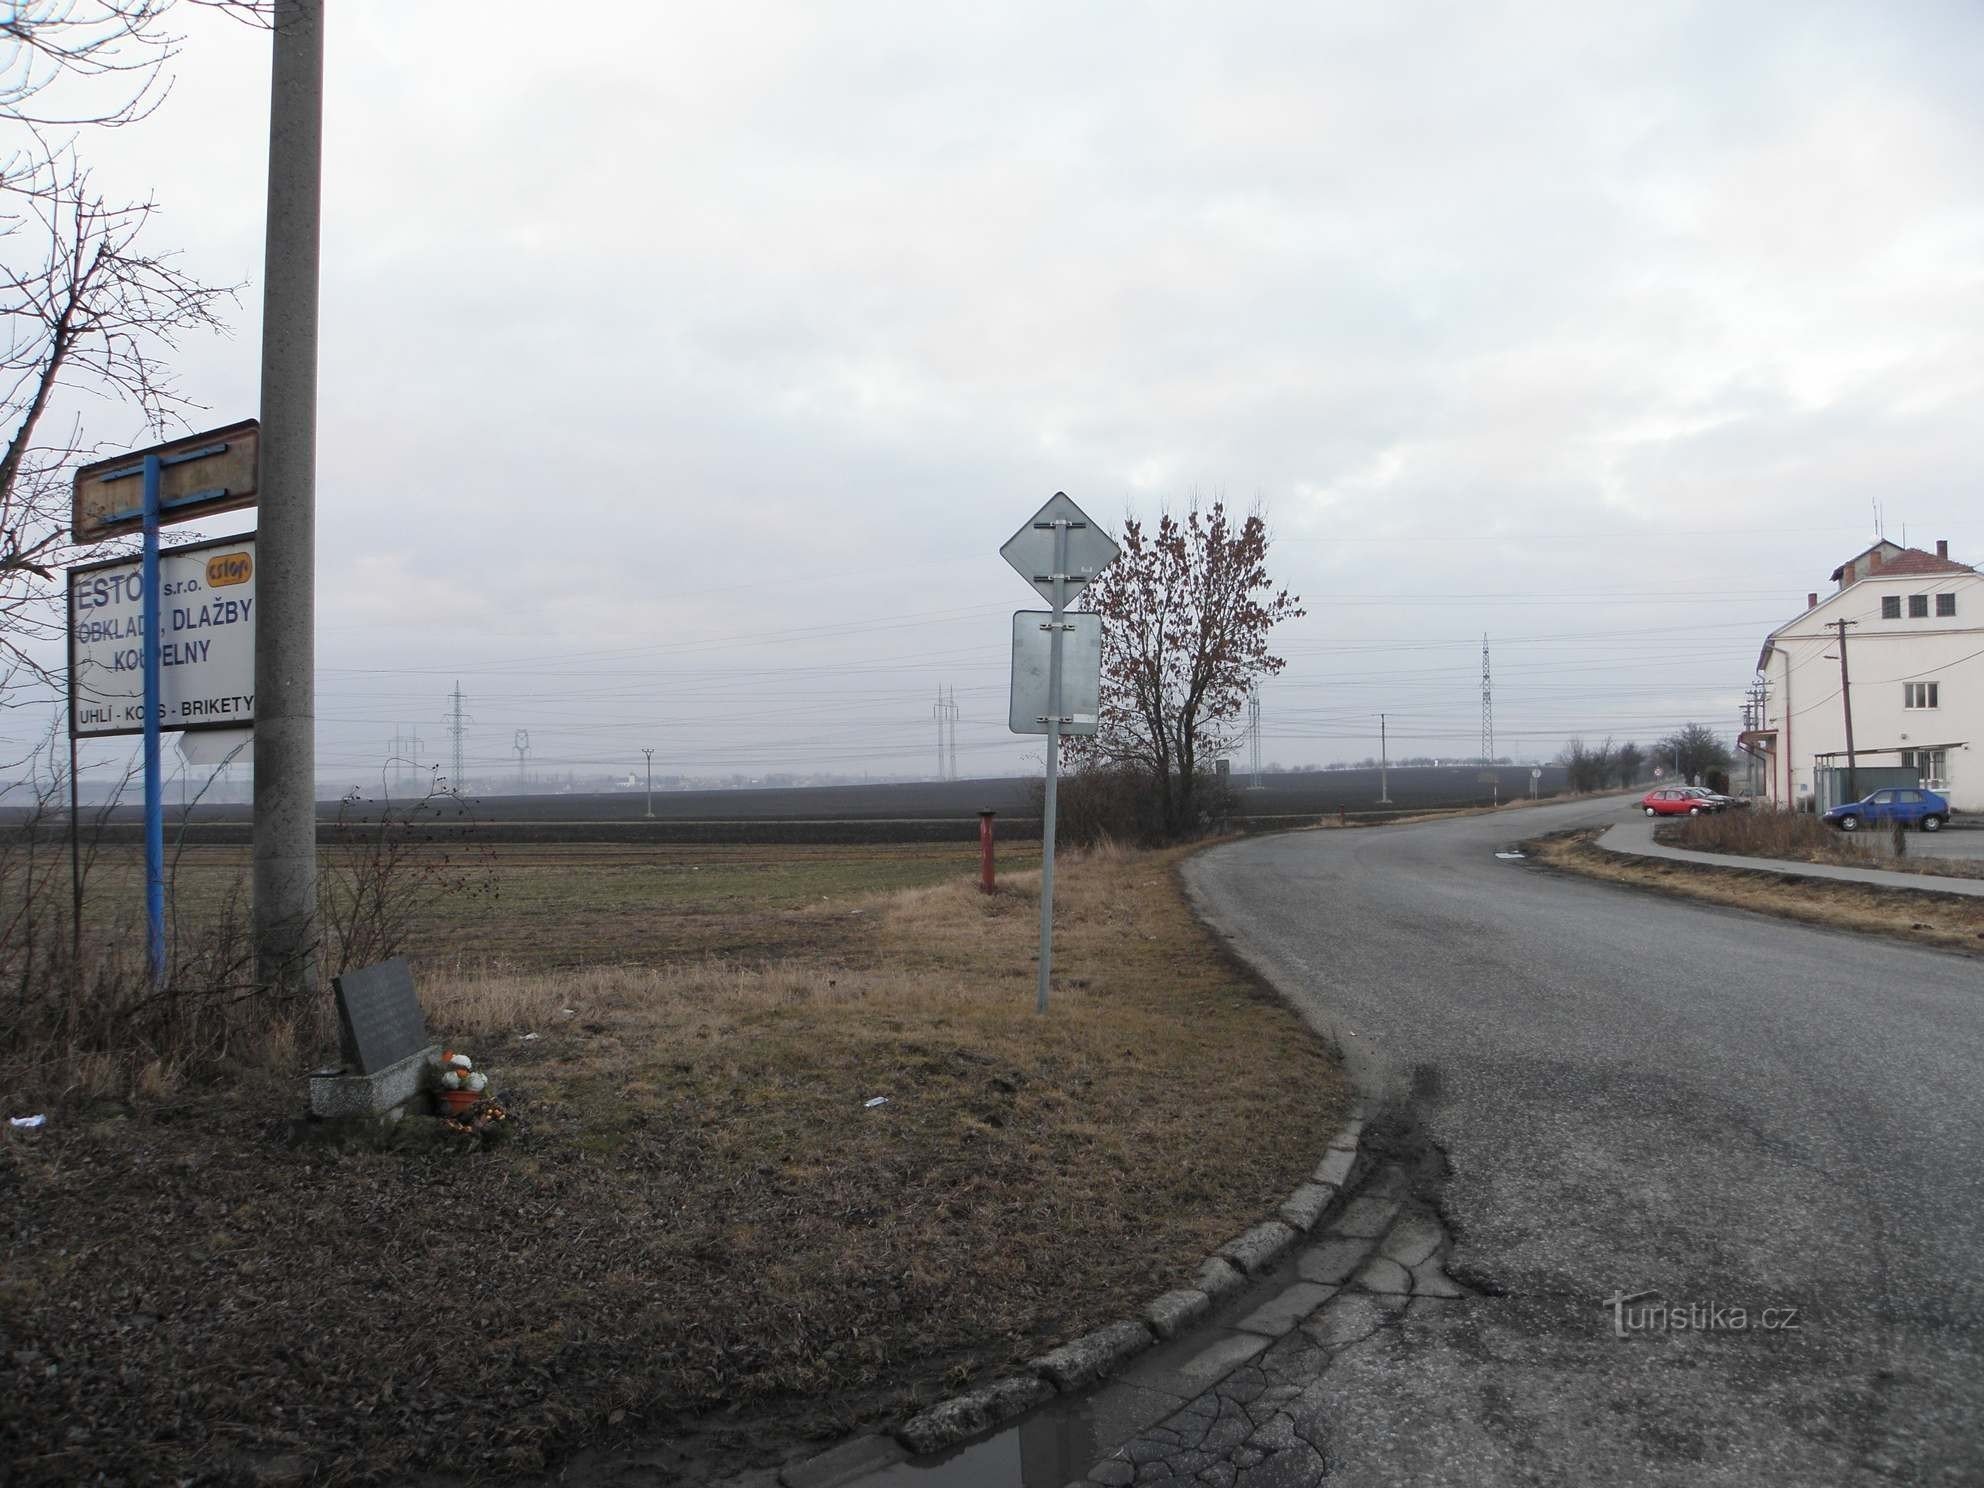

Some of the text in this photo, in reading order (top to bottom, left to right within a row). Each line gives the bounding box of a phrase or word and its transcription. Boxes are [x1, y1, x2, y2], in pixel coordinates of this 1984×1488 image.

[78, 571, 202, 610] ESTO s.r.o.
[172, 597, 253, 632] DLAŽBY
[114, 639, 211, 673] KOELNY
[80, 705, 113, 724] UHLÍ
[125, 703, 167, 721] KOS
[181, 695, 255, 717] BRIKETY
